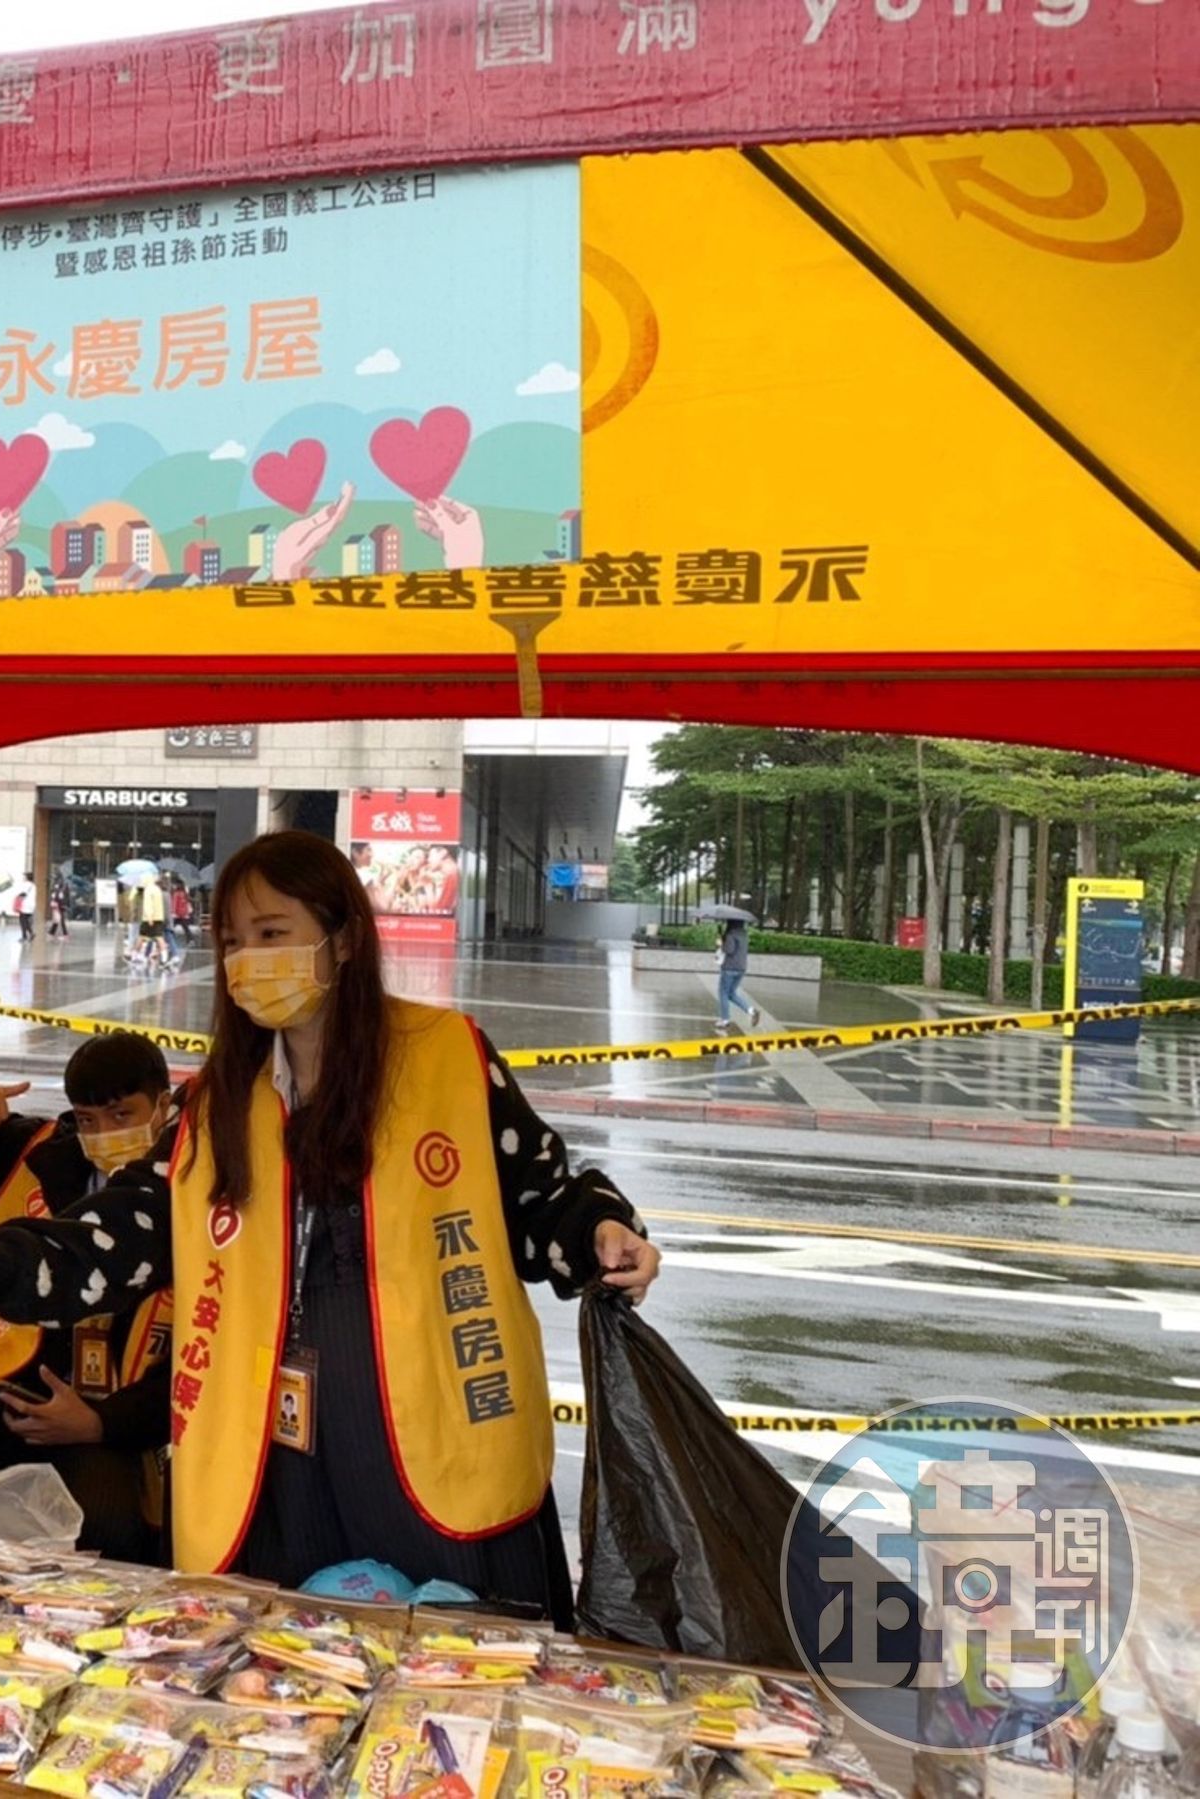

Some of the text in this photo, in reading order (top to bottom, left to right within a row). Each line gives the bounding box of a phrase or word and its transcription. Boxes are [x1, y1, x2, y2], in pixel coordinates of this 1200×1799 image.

[54, 226, 289, 278] 暨感恩祖孫節活動
[63, 789, 188, 807] STARBUCKS
[432, 1210, 516, 1425] 永慶房屋
